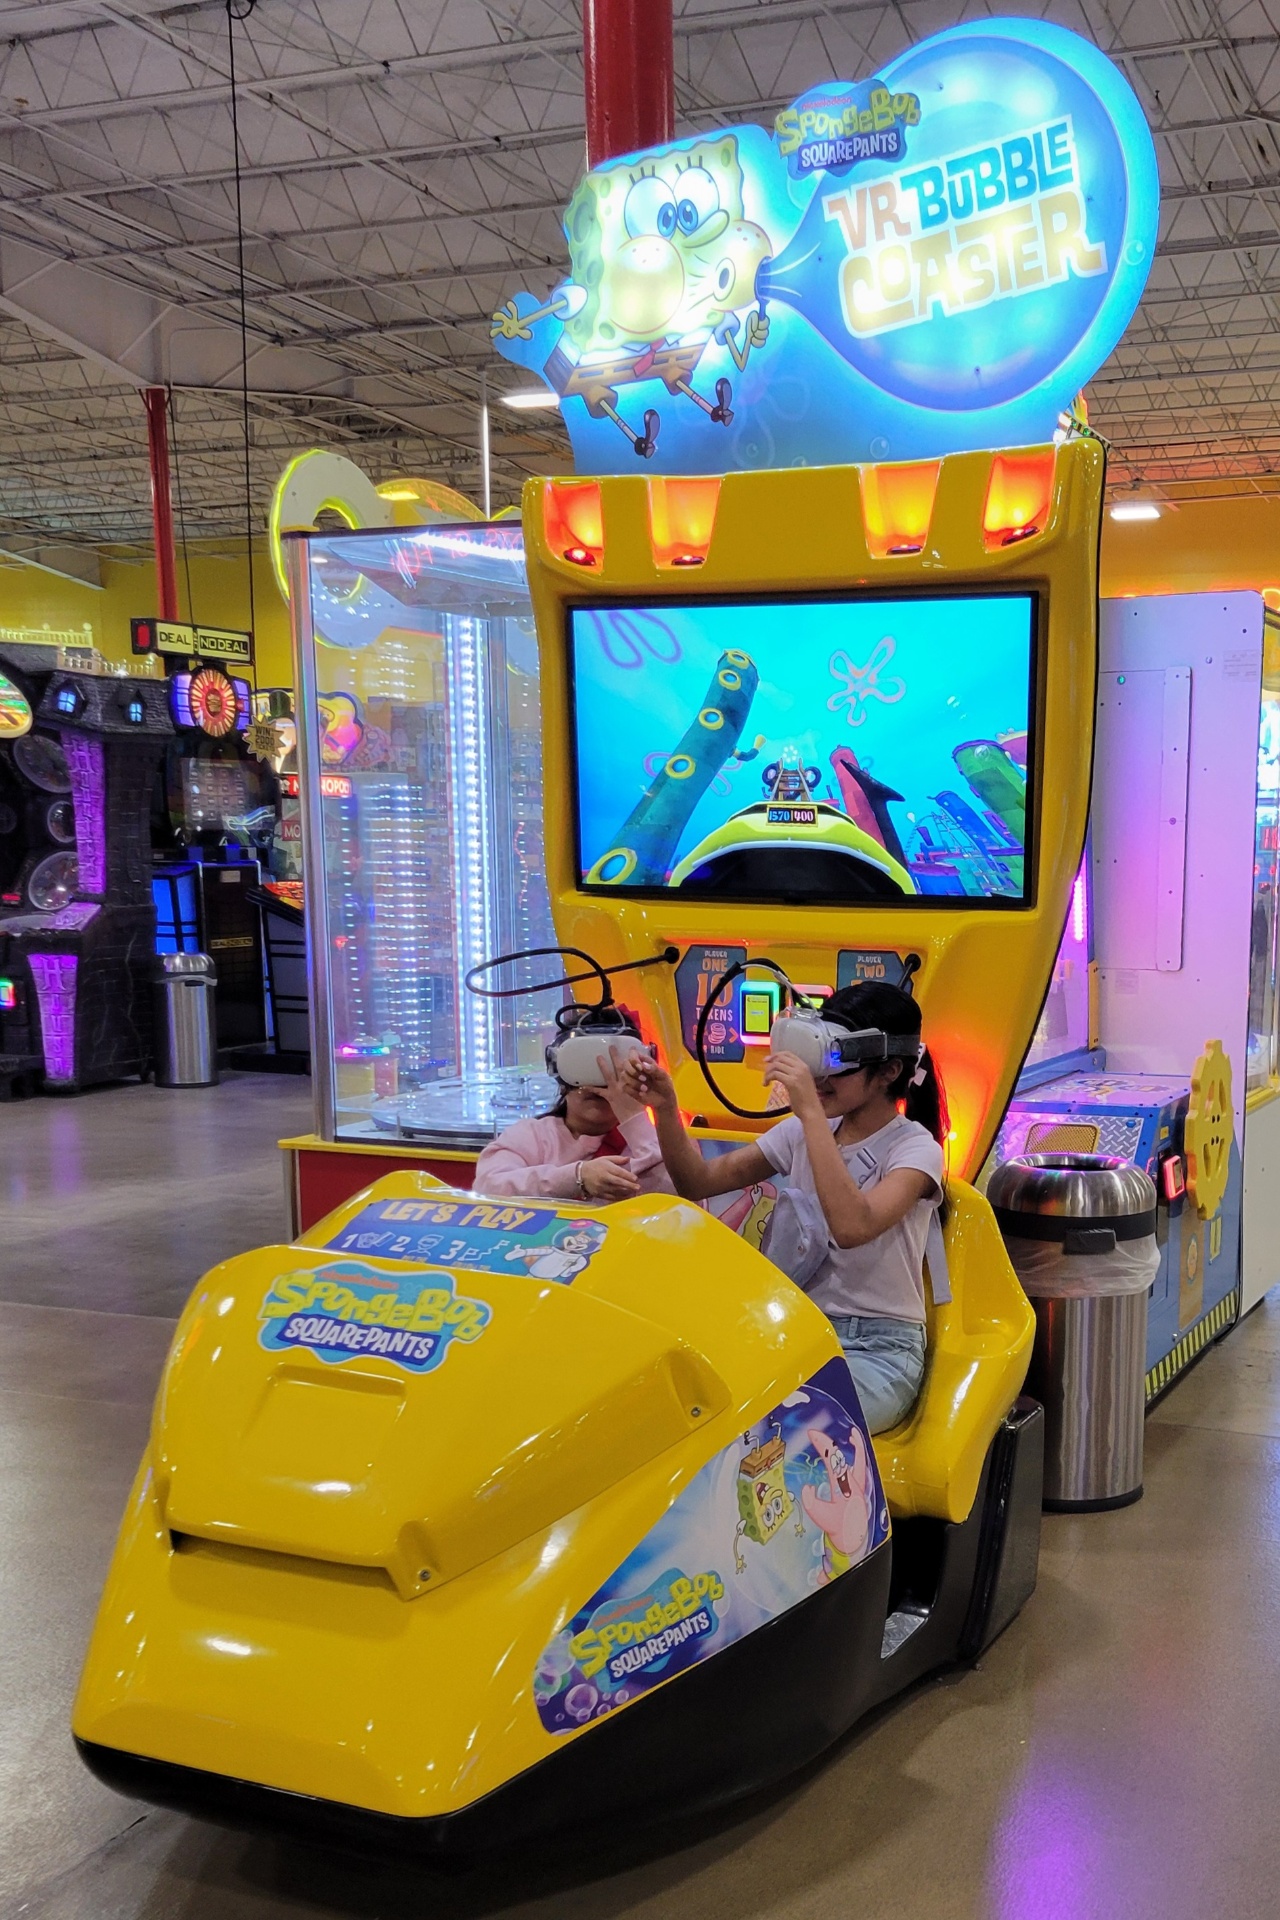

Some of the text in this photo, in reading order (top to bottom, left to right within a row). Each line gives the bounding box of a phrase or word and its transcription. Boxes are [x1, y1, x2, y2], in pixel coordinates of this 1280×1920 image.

[801, 132, 898, 168] SQUAREPANTS
[828, 122, 1074, 251] VR BUBBLE
[842, 190, 1104, 334] COASTER
[160, 631, 192, 646] DEAL
[794, 811, 814, 822] 400
[702, 958, 729, 972] ONE
[856, 963, 886, 979] TWO
[857, 955, 882, 964] PLAYER
[696, 973, 734, 1008] 10
[695, 1007, 734, 1022] TKENS
[379, 1201, 537, 1231] LET'S PLAY
[340, 1233, 359, 1249] 1
[388, 1236, 412, 1252] 2
[440, 1240, 467, 1260] 3
[261, 1273, 486, 1341] SpongeBob
[284, 1317, 434, 1359] SQUAREPANTS
[569, 1573, 725, 1680] SpongeBob
[610, 1611, 710, 1678] SQUAREPANTS
